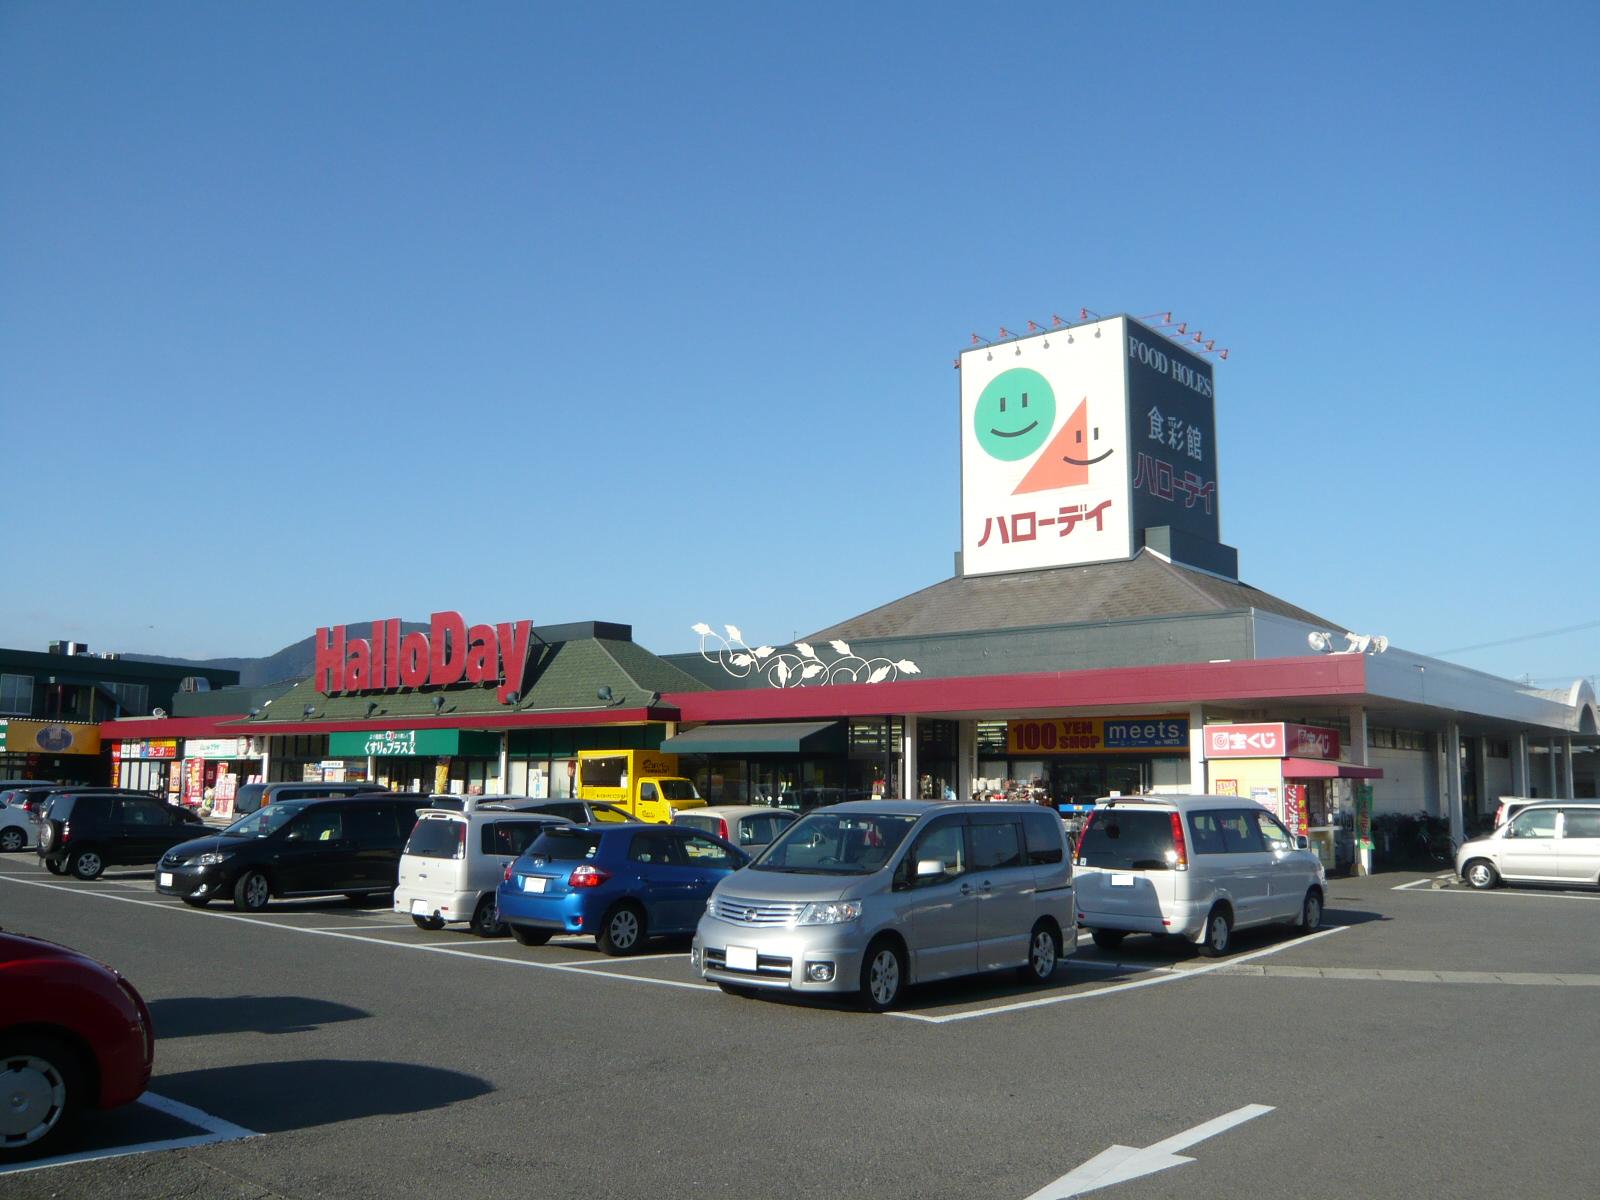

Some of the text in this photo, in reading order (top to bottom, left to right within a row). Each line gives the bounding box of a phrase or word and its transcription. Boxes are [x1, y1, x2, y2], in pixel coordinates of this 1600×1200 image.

[1128, 335, 1213, 399] FOOD HOLES
[1147, 405, 1203, 462] 食彩館
[1133, 452, 1216, 515] ハローデイ
[977, 499, 1112, 548] ハローデイ
[314, 610, 534, 705] HalloDay
[1013, 722, 1057, 750] 100
[1059, 735, 1100, 750] SHOP
[1062, 720, 1093, 735] YEN
[1229, 732, 1276, 750] 宝くじ
[1305, 732, 1330, 754] 宝くじ
